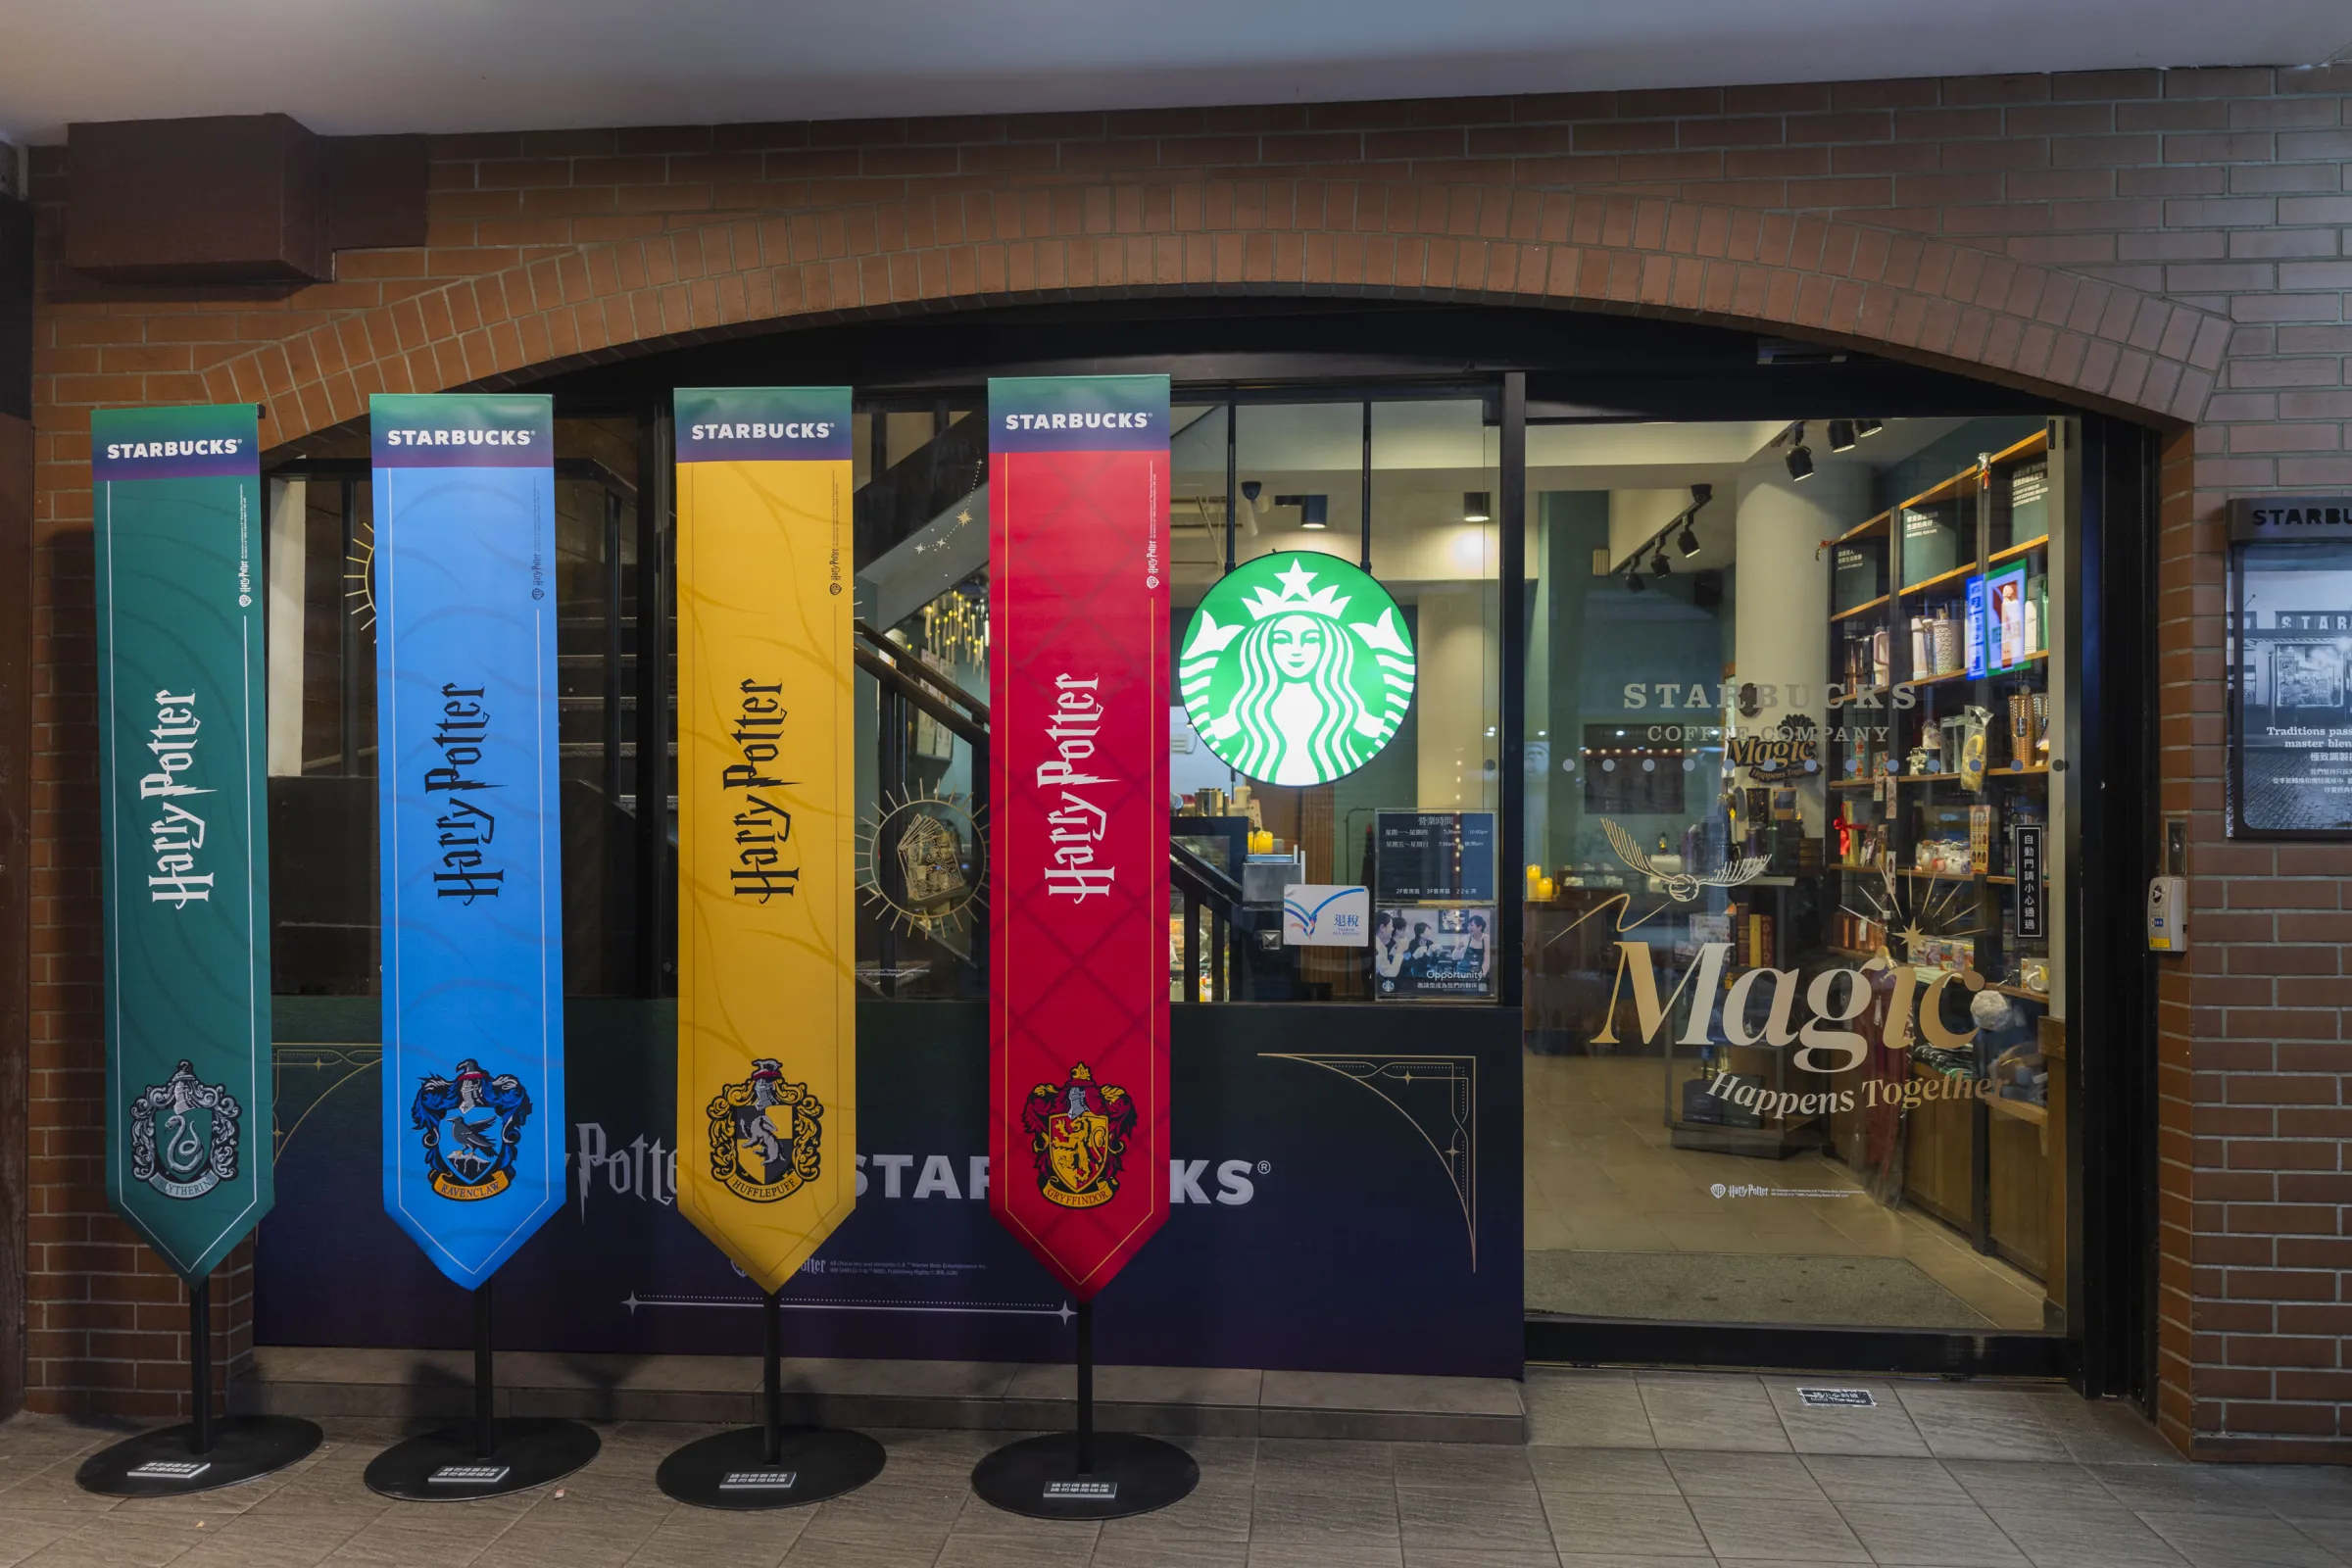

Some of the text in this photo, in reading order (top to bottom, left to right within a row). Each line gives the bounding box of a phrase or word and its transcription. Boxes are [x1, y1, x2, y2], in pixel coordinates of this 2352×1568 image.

[829, 548, 841, 564] Potter
[1146, 540, 1158, 557] Potter
[238, 561, 252, 576] Potter
[531, 553, 544, 570] Potter
[1147, 558, 1158, 574] Harry
[532, 570, 544, 586] Harry
[830, 564, 841, 581] Harry
[239, 576, 251, 593] Harry
[1624, 683, 1917, 710] STARBUCKS
[1647, 725, 1890, 742] COFFEE COMPANY
[2267, 727, 2326, 736] Traditions
[2284, 739, 2324, 748] master
[1727, 737, 1817, 768] Magic
[424, 682, 509, 906] Harry Potter
[723, 678, 802, 905] Harry Potter
[1037, 673, 1122, 904] Harry Potter
[140, 687, 219, 910] Harry Potter
[2024, 835, 2034, 930] 自動門請小心通過
[1334, 913, 1359, 927] 退稅
[1426, 970, 1483, 981] Opportunity
[1591, 940, 1985, 1073] Magic
[1705, 1068, 2010, 1120] Happens Together
[575, 1122, 677, 1225] Potte
[441, 1181, 500, 1198] RAVENCLAW
[732, 1178, 798, 1198] HUFFLEPUFF
[1728, 1185, 1747, 1198] Harry
[1748, 1184, 1769, 1200] Potter
[1047, 1189, 1107, 1205] GRYFFINDOR
[801, 1257, 826, 1274] otter
